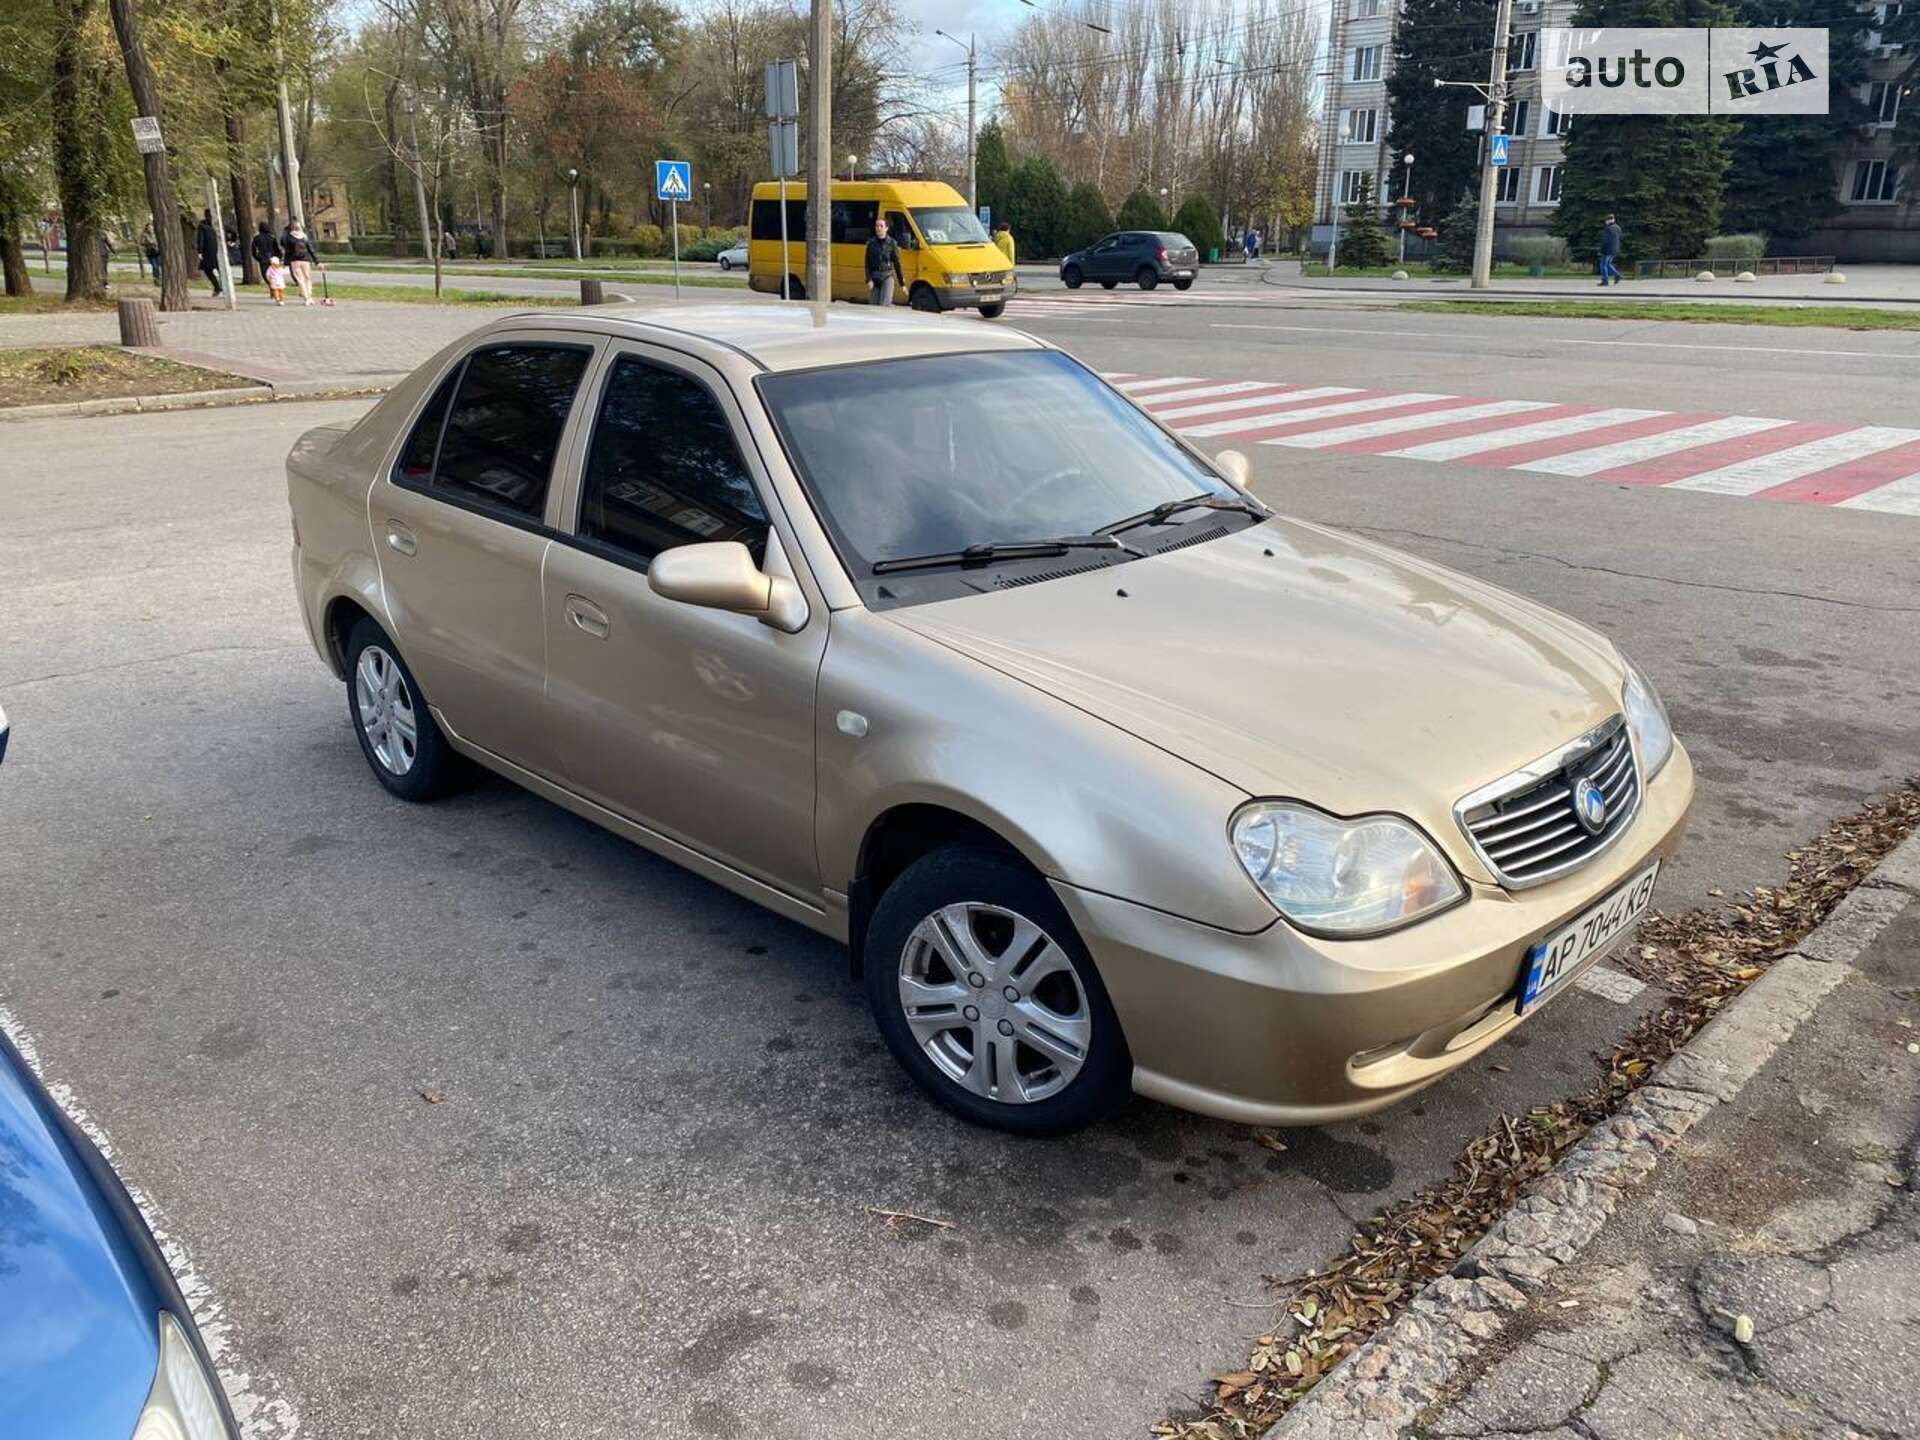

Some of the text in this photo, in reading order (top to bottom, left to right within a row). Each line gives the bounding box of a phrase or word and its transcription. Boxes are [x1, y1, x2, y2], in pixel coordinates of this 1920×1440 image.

[1541, 874, 1652, 986] AP 7044 KB
